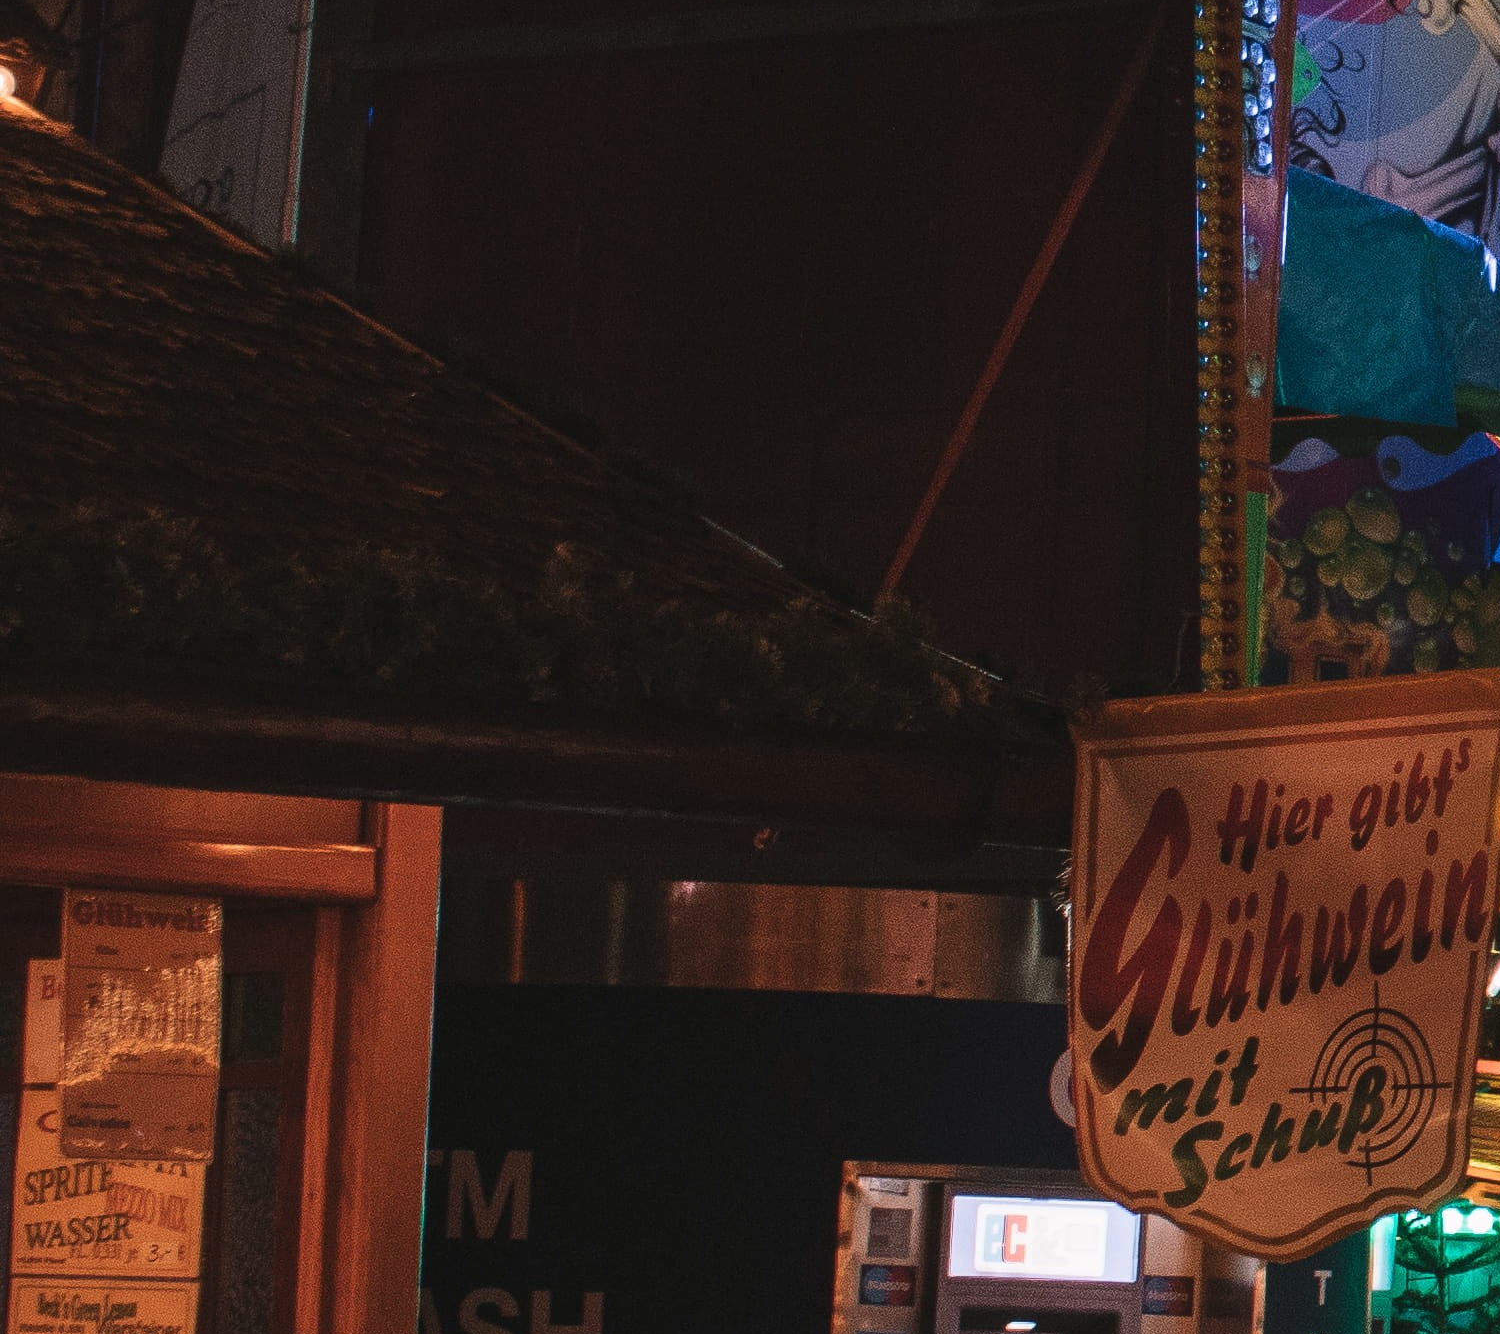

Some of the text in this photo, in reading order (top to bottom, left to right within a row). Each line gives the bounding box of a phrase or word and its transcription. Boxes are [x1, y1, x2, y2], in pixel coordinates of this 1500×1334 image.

[1218, 779, 1333, 873] Hier
[72, 901, 213, 931] Glühwei
[1080, 788, 1489, 1094] Glühwein
[1114, 1037, 1259, 1136] mit
[24, 1160, 113, 1207] SPRITE
[1165, 1066, 1386, 1208] Schuß
[25, 1213, 133, 1251] WASSER
